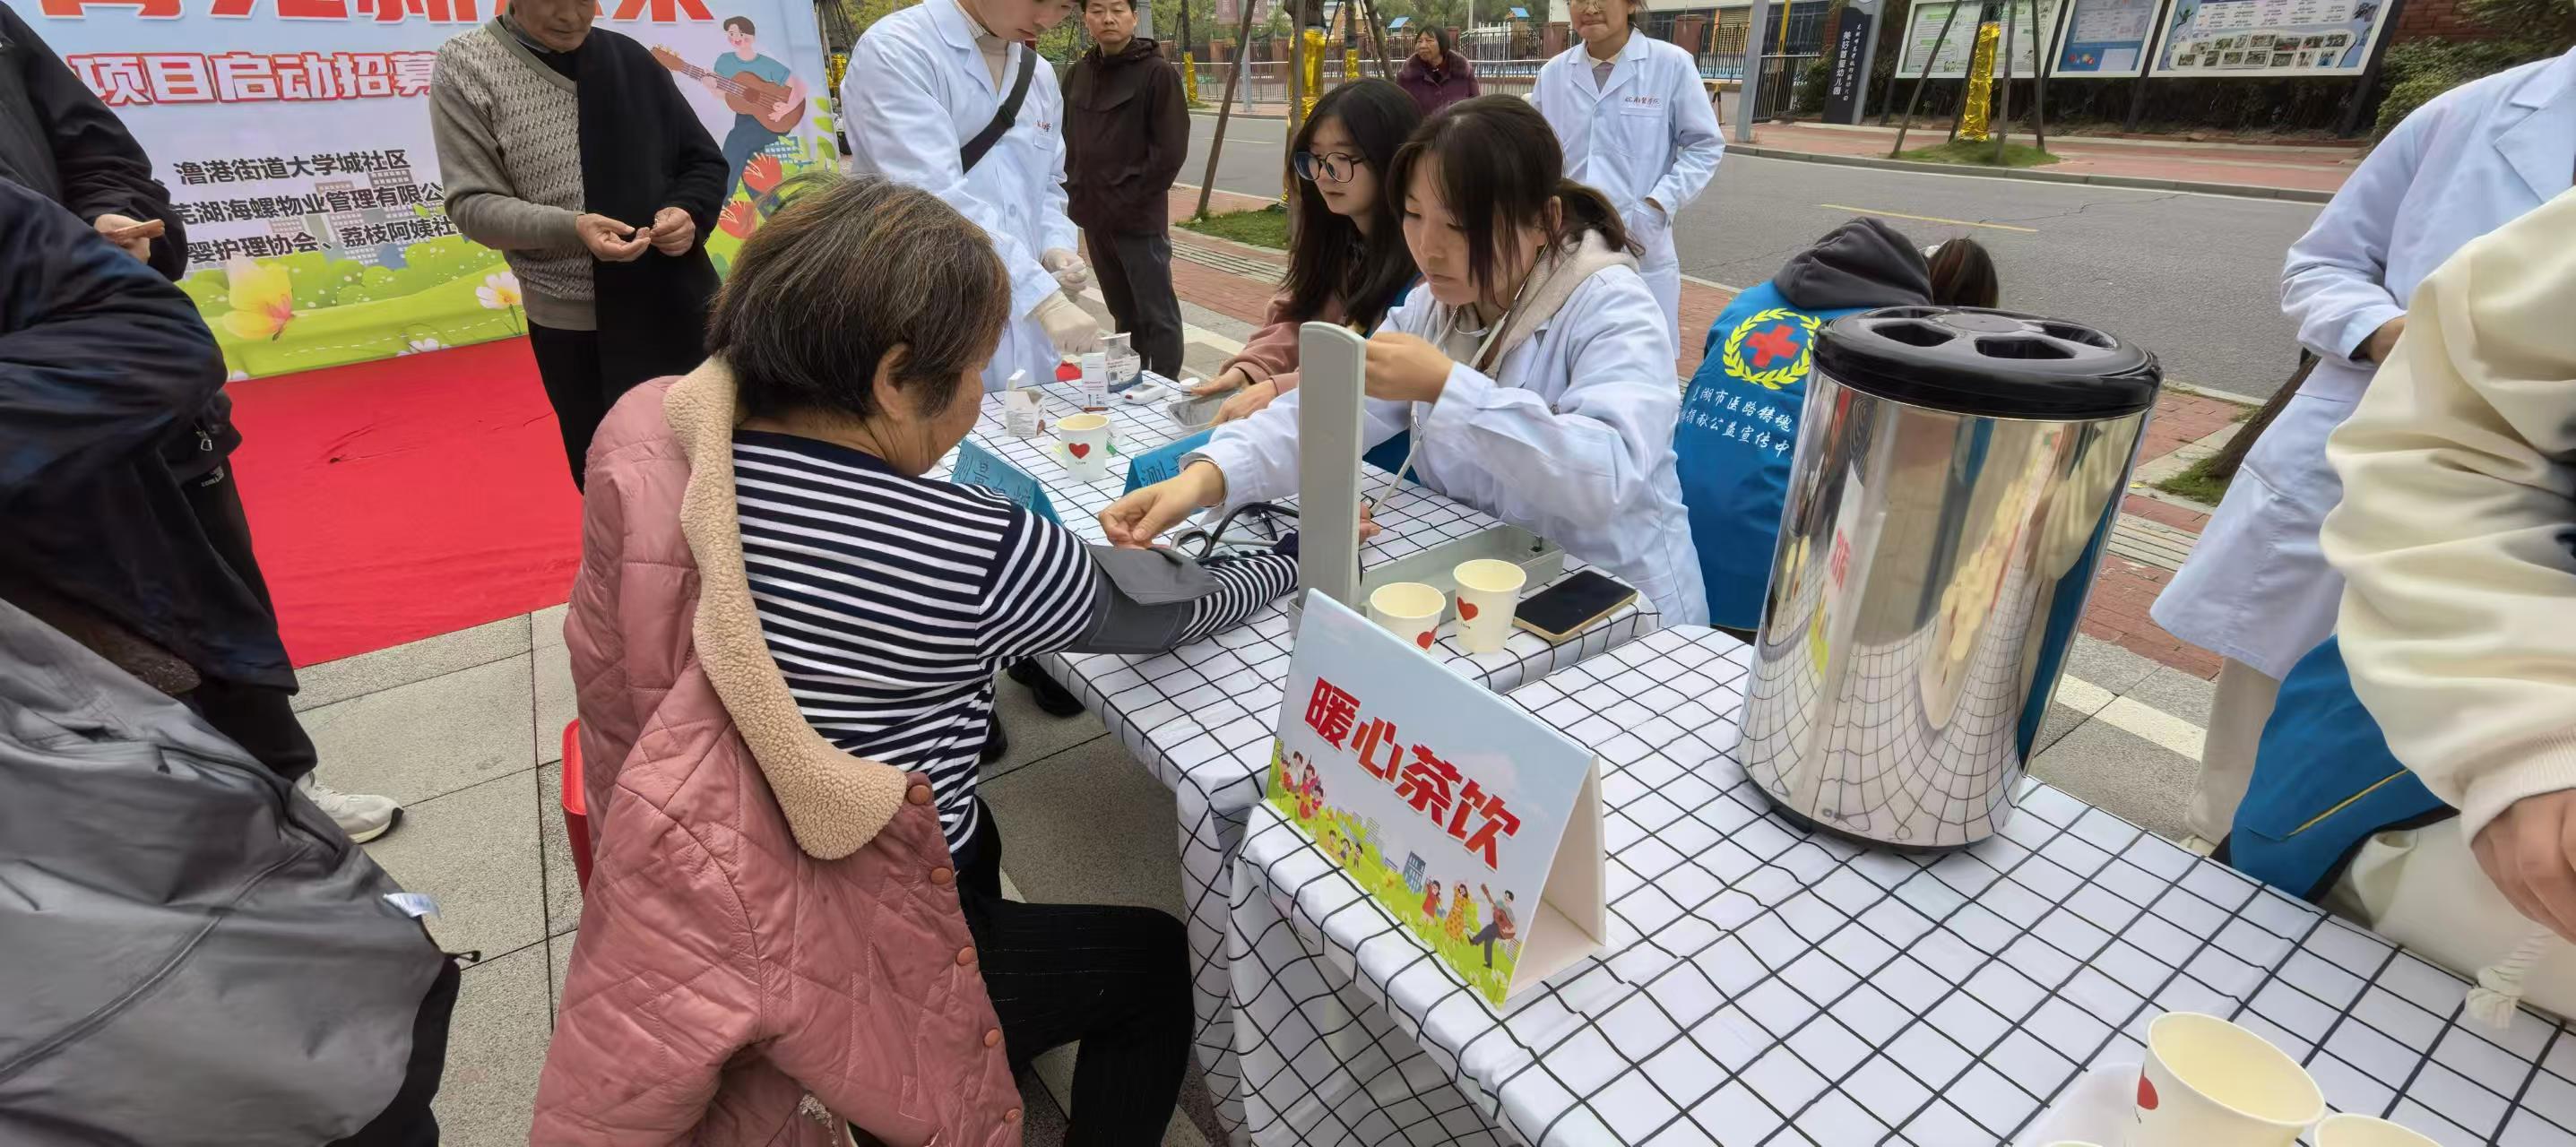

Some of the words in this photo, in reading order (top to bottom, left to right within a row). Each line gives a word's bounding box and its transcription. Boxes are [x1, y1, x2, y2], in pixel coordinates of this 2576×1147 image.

[67, 52, 435, 106] 项目启动招募
[1304, 676, 1521, 871] 暖心茶饮
